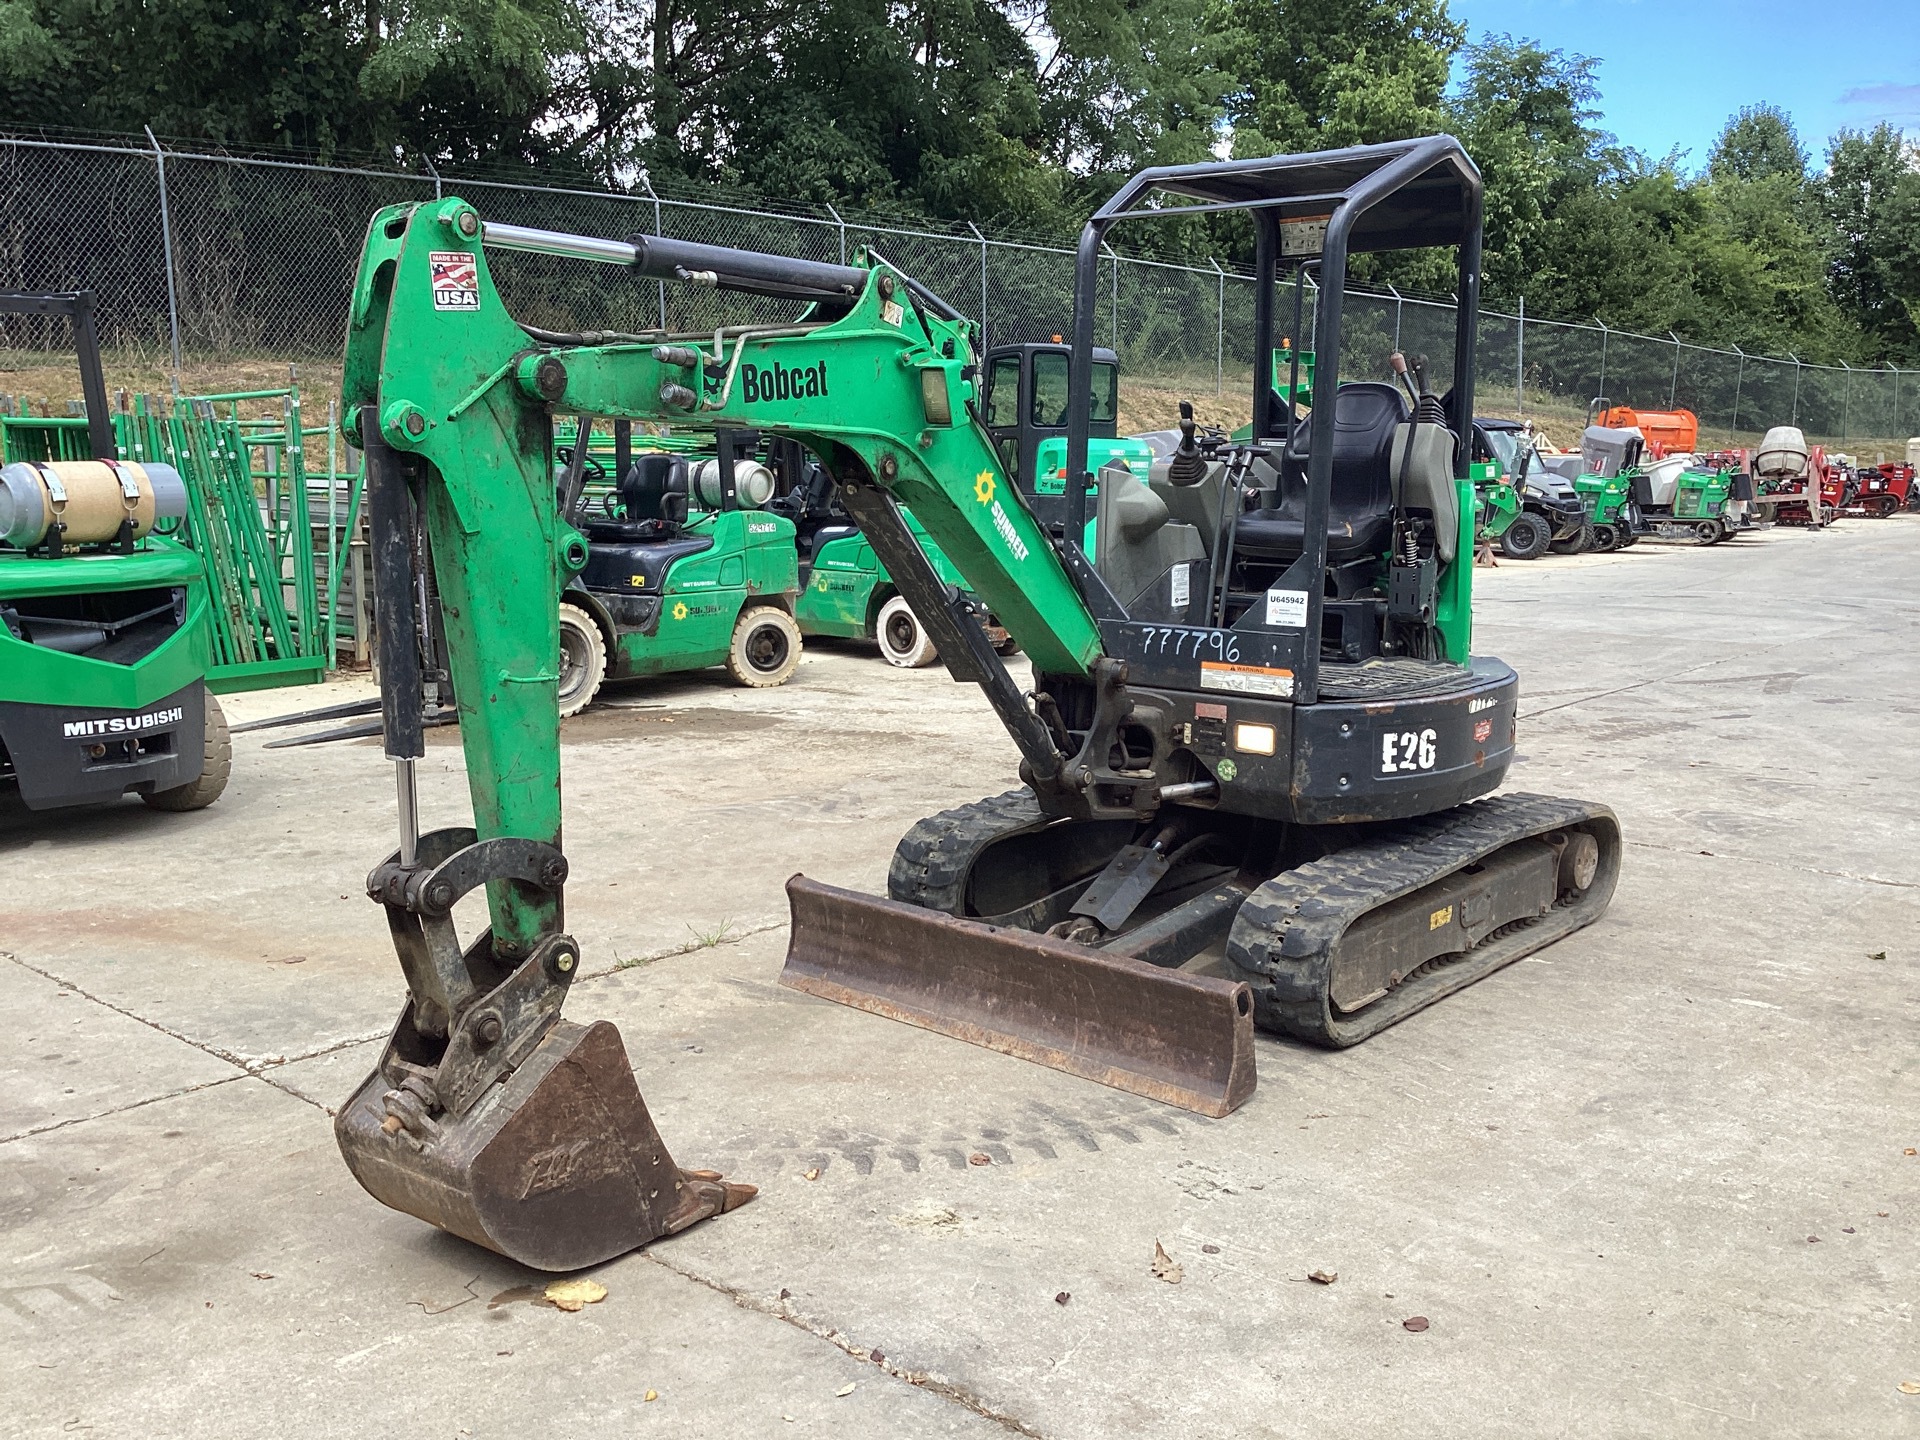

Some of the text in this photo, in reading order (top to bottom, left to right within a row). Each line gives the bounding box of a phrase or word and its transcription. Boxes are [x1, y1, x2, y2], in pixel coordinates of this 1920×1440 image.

[436, 291, 477, 305] USA
[742, 360, 828, 403] Bobcat
[991, 500, 1030, 562] SUNBELT
[993, 518, 1019, 560] RENTALS
[1270, 595, 1305, 605] U645942
[1142, 627, 1240, 663] 777796
[1236, 665, 1265, 675] WARNING
[63, 707, 183, 737] MITSUBISHI
[1381, 728, 1437, 773] E26
